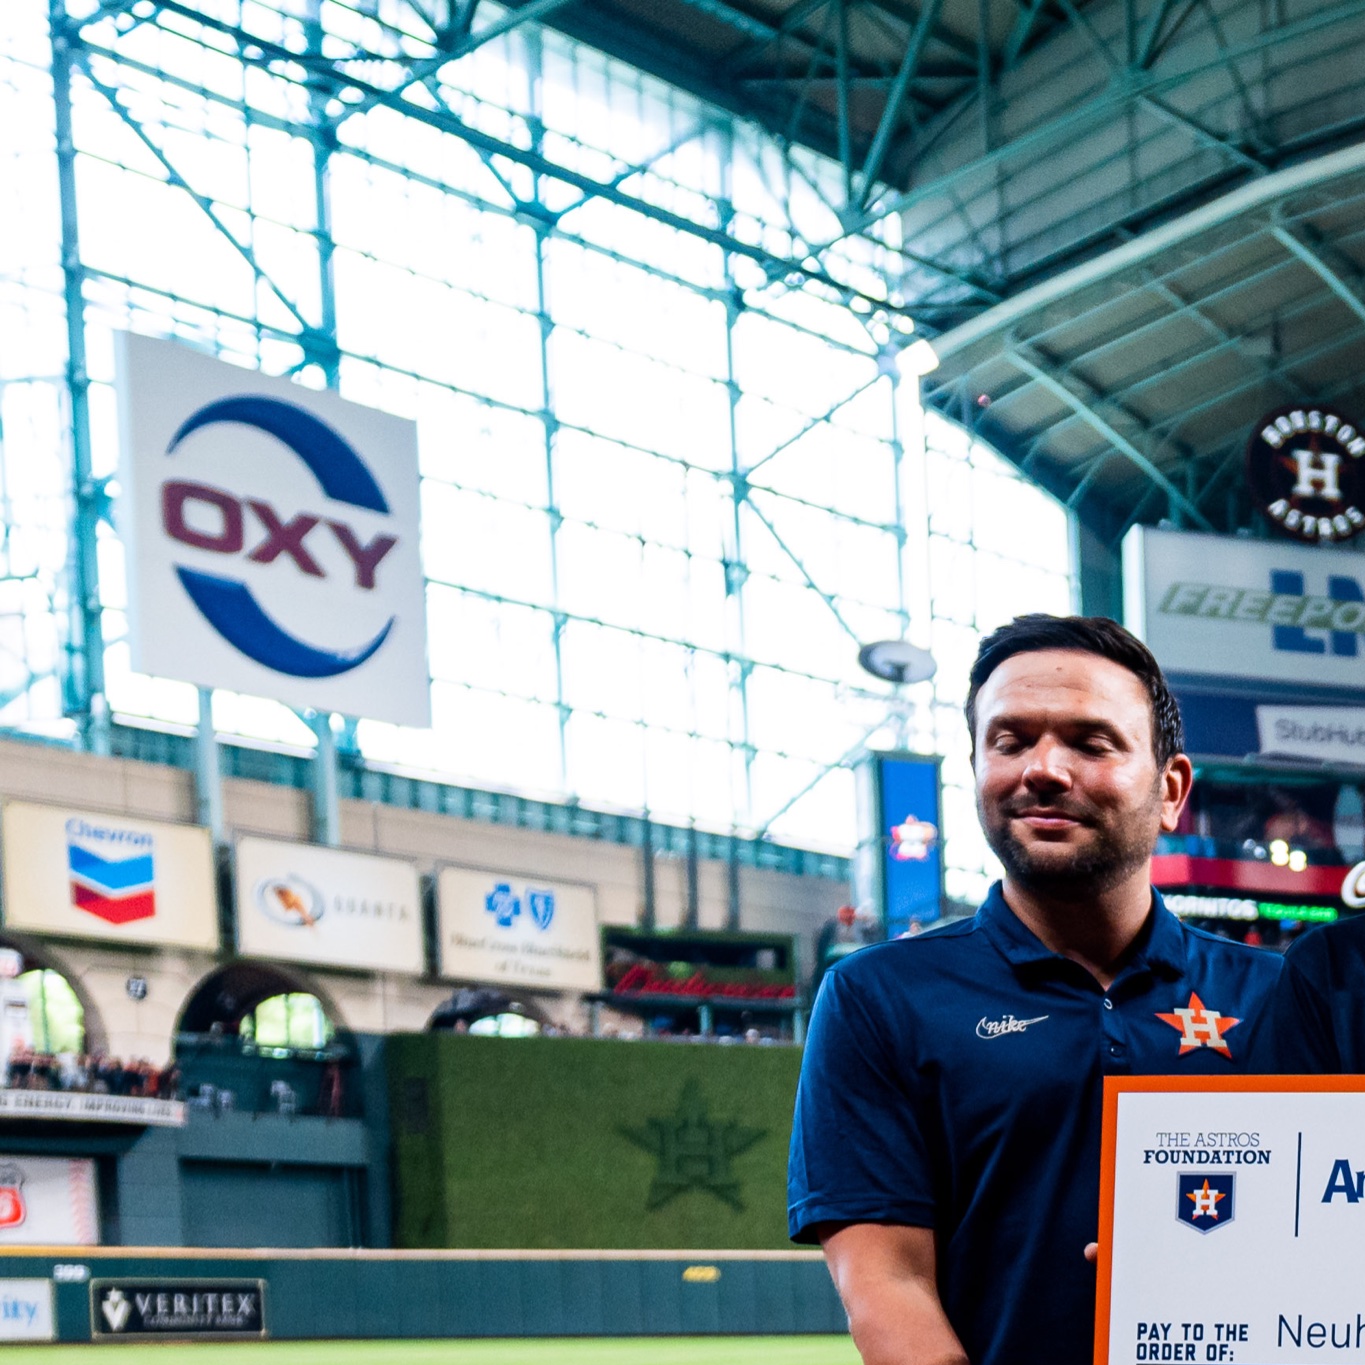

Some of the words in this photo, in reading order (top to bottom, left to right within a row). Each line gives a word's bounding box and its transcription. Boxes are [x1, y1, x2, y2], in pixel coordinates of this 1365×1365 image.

[1291, 449, 1342, 499] H
[1268, 498, 1365, 539] ASTROS
[160, 479, 398, 590] OXY
[66, 817, 154, 848] Chevron
[987, 1014, 1028, 1035] nike
[1173, 1008, 1228, 1048] H
[1156, 1132, 1190, 1147] THE
[1195, 1132, 1260, 1147] ASTROS
[1143, 1149, 1272, 1165] FOUNDATION
[1193, 1189, 1219, 1216] H
[135, 1293, 256, 1316] VERITEX
[1137, 1323, 1172, 1341] PAY
[1181, 1323, 1204, 1342] TO
[1215, 1324, 1249, 1342] THE
[1136, 1343, 1196, 1361] ORDER
[1206, 1344, 1235, 1361] OF:
